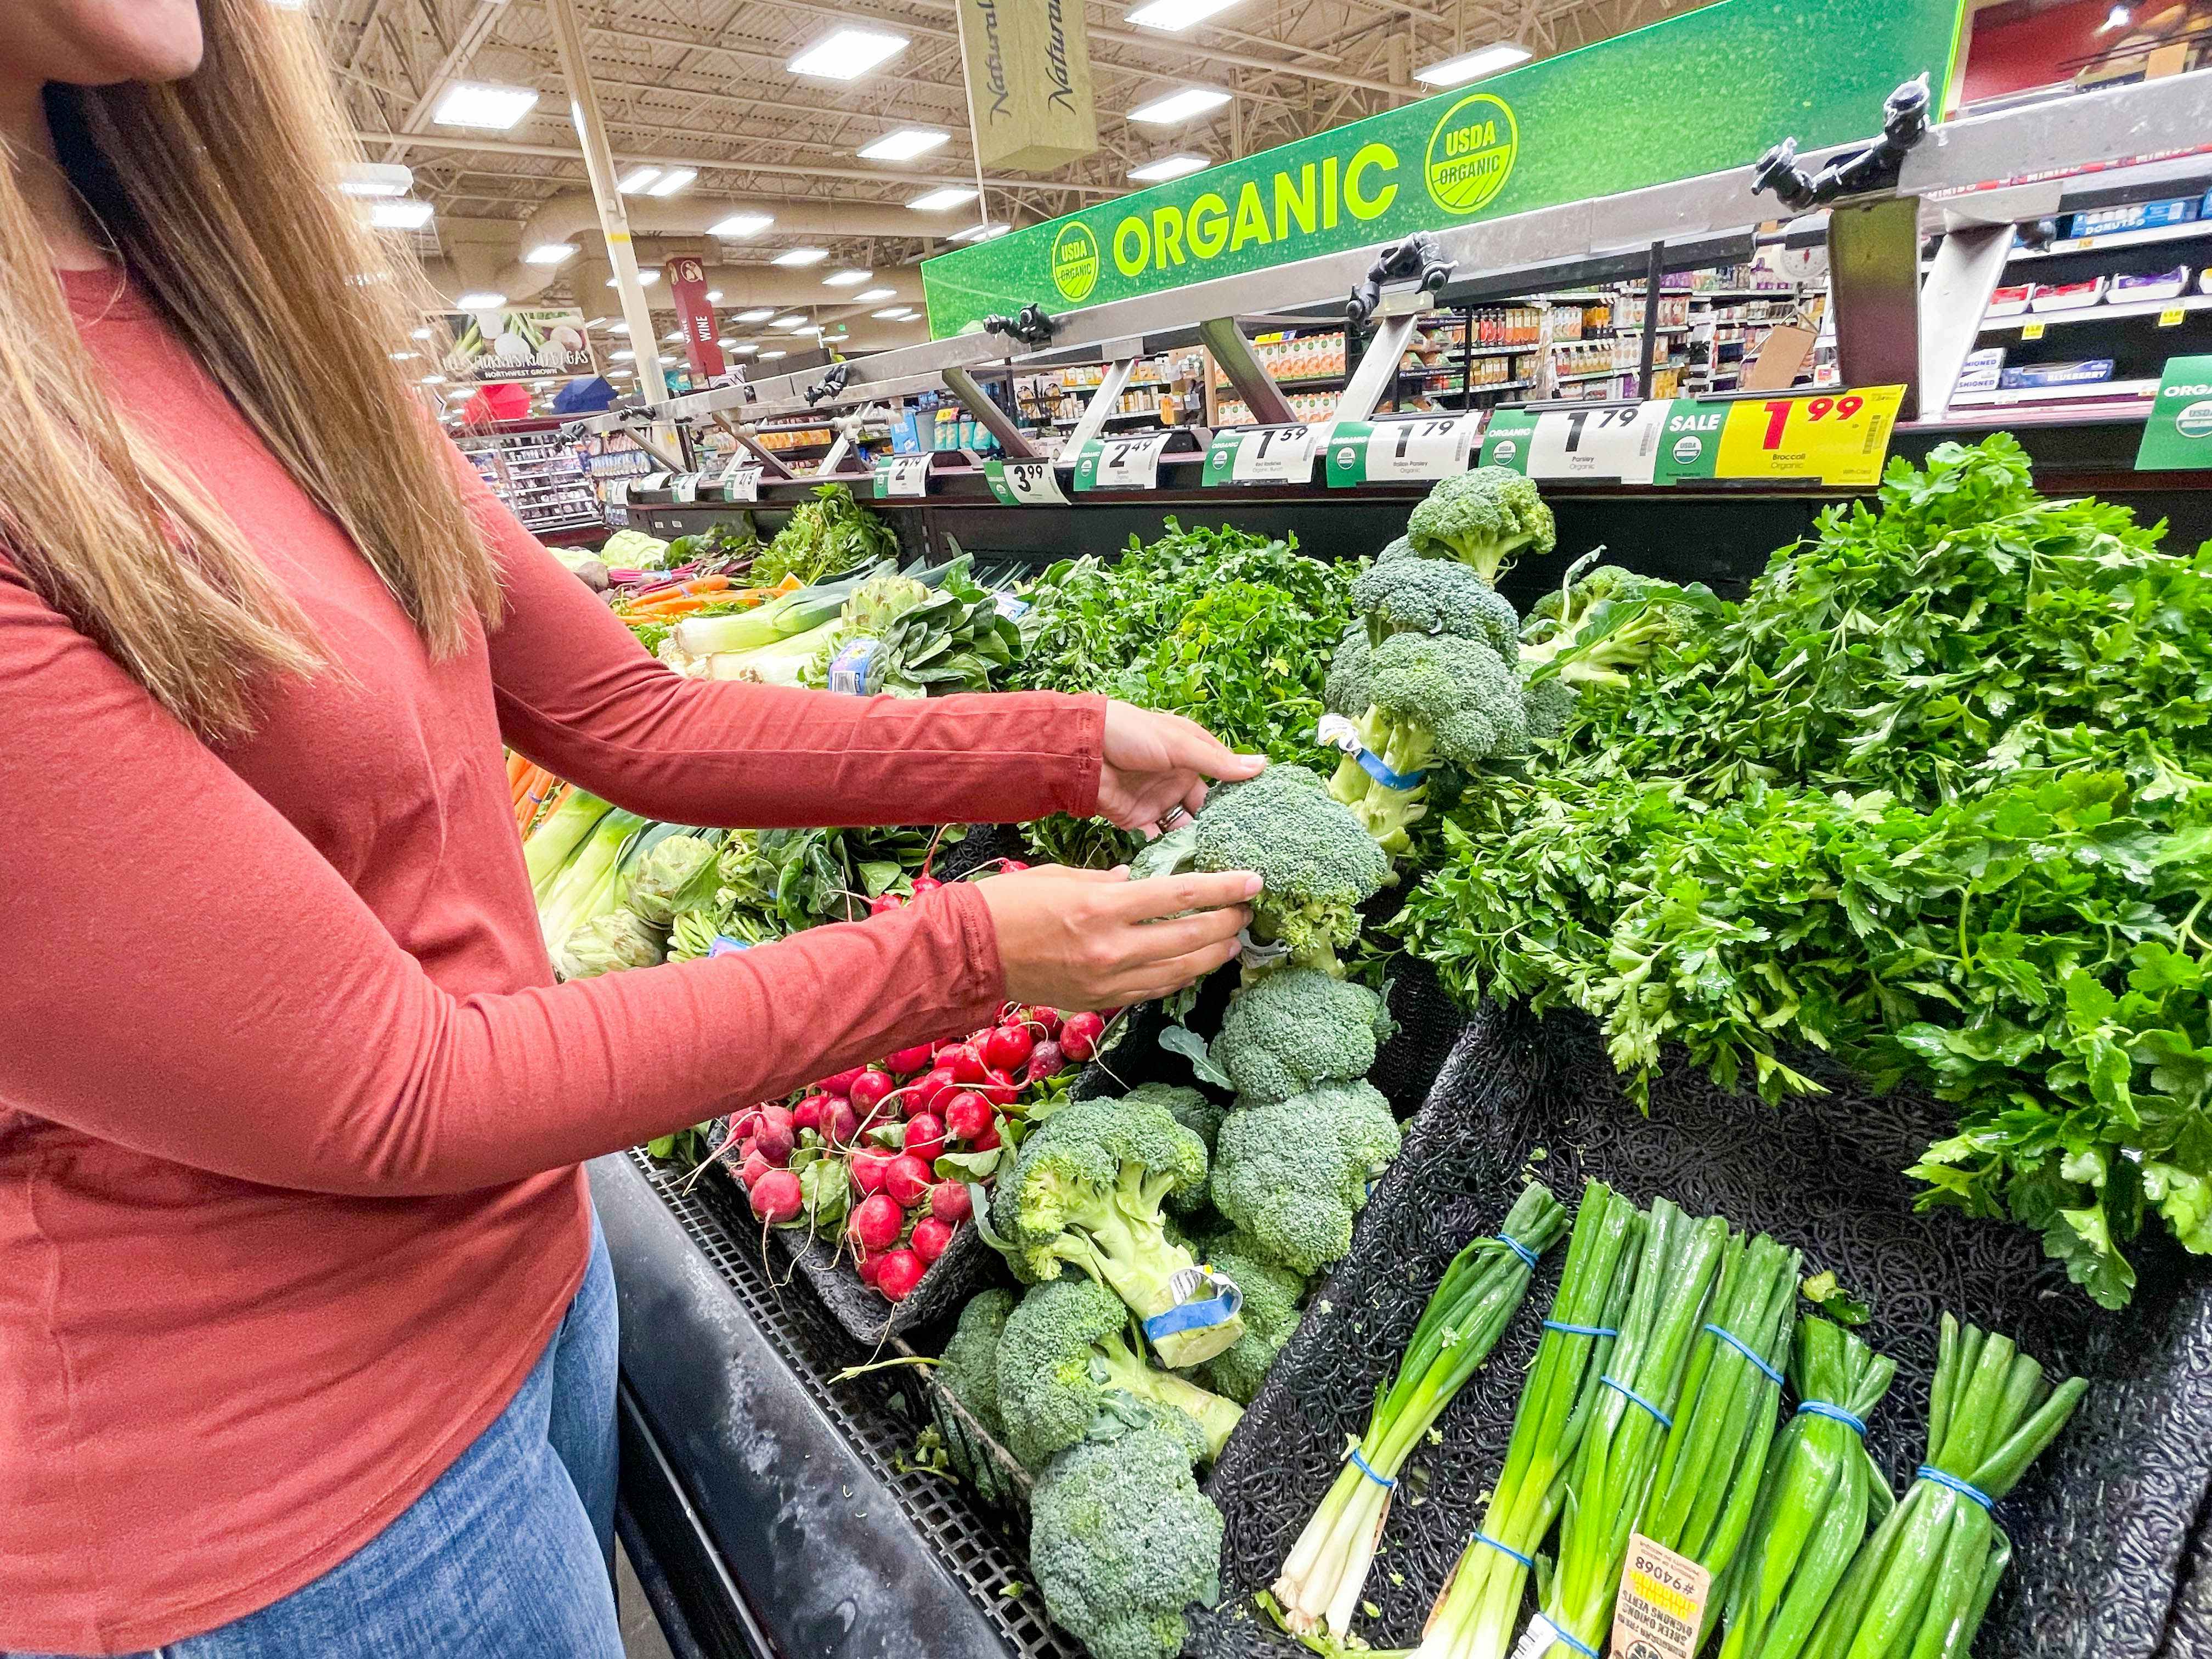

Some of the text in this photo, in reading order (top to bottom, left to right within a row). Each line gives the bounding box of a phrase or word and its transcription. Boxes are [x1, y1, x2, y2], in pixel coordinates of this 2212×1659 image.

[1045, 0, 1076, 115] Natura
[1446, 121, 1496, 156] USDA
[1440, 155, 1500, 185] ORGANIC
[1113, 143, 1399, 277] ORGANIC
[1061, 240, 1087, 262] USDA
[1061, 263, 1091, 281] ORGANIC
[695, 316, 712, 342] WINE
[484, 369, 529, 378] NORTHWEST
[2047, 370, 2107, 381] BLUEBERRY
[1488, 427, 1532, 437] ORGANIC
[1565, 408, 1638, 452] 1 79
[1669, 414, 1722, 432] SALE
[1763, 397, 1863, 449] 1 99
[1257, 427, 1308, 459] 1 59
[1331, 436, 1368, 445] ORGANIC
[1395, 420, 1454, 458] 1 79
[1109, 440, 1152, 468] 2 49
[895, 458, 909, 481] 2
[1014, 465, 1042, 492] 3 99
[1635, 1556, 1695, 1595] #94068
[1634, 1583, 1688, 1622] ORGANIC
